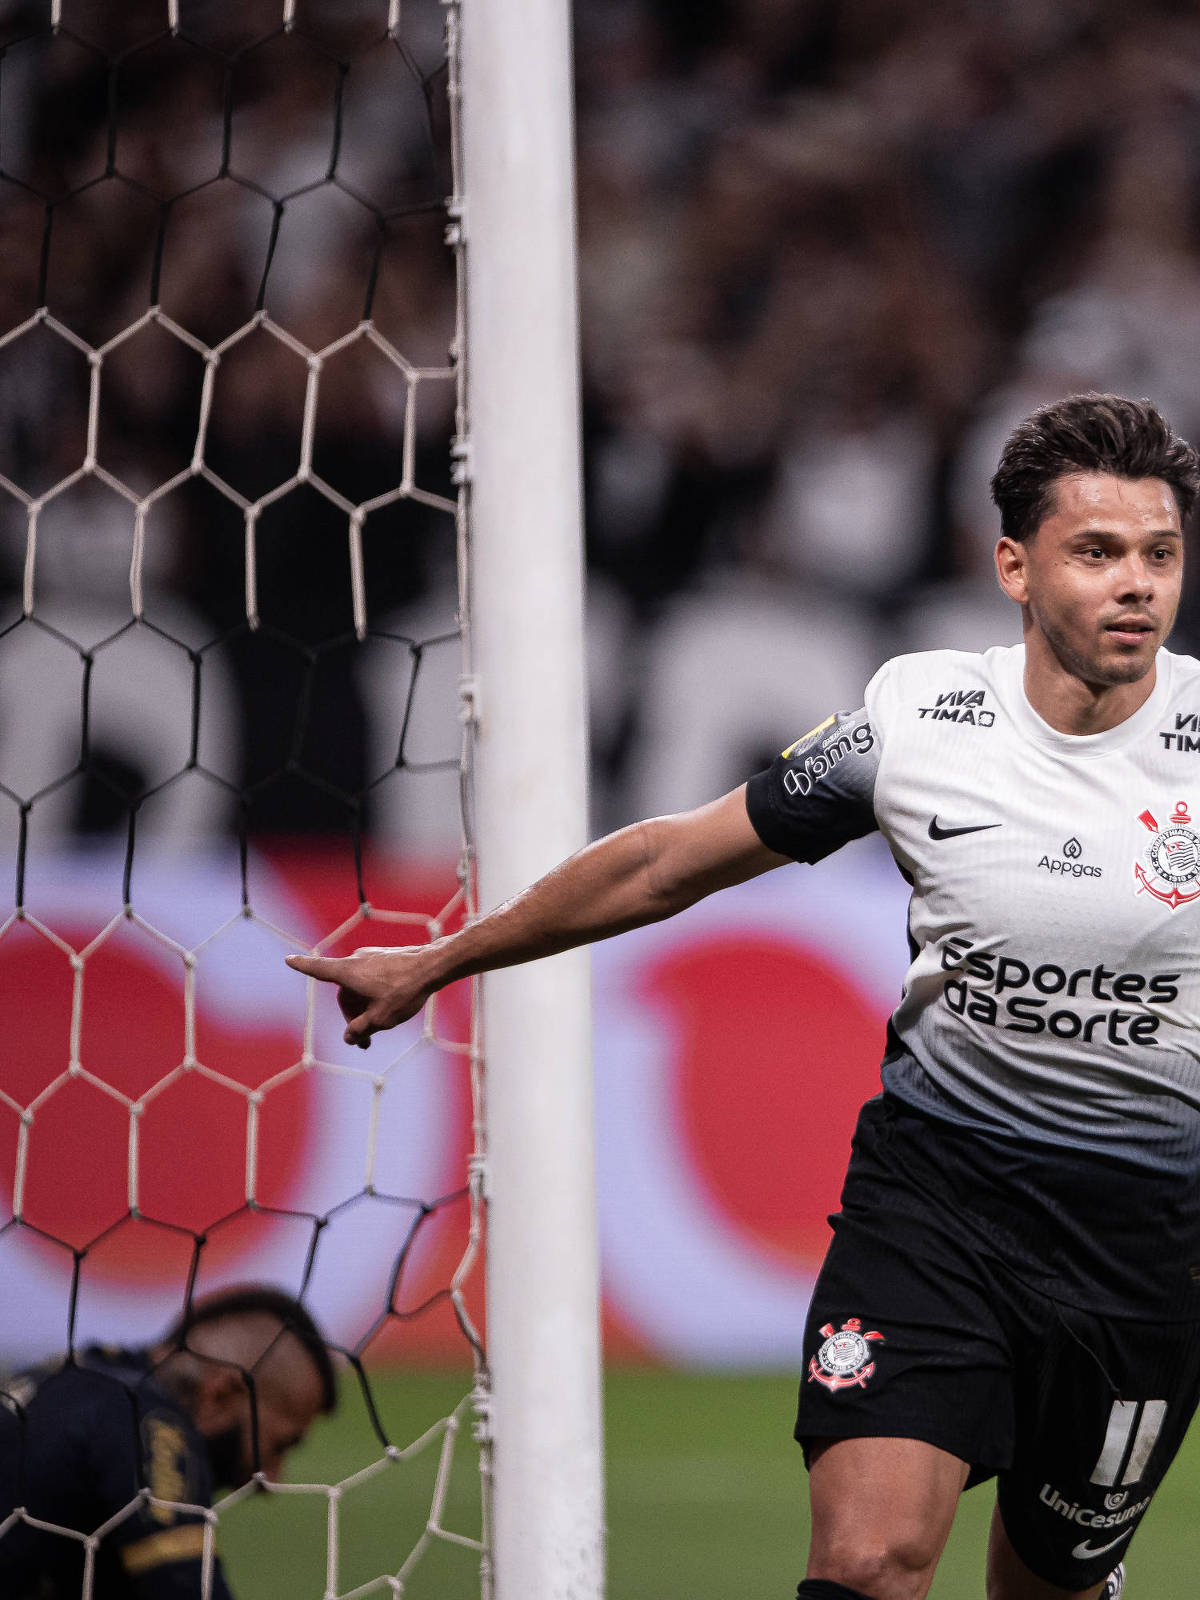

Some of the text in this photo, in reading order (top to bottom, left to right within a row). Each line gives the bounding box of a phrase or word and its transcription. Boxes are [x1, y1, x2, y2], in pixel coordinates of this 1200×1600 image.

[918, 704, 995, 728] TIMÃO
[935, 690, 986, 707] VIVA
[1037, 855, 1102, 878] Appgas
[940, 936, 1181, 1004] Esportes
[1004, 995, 1161, 1046] Sorte
[1089, 1399, 1168, 1487] 11
